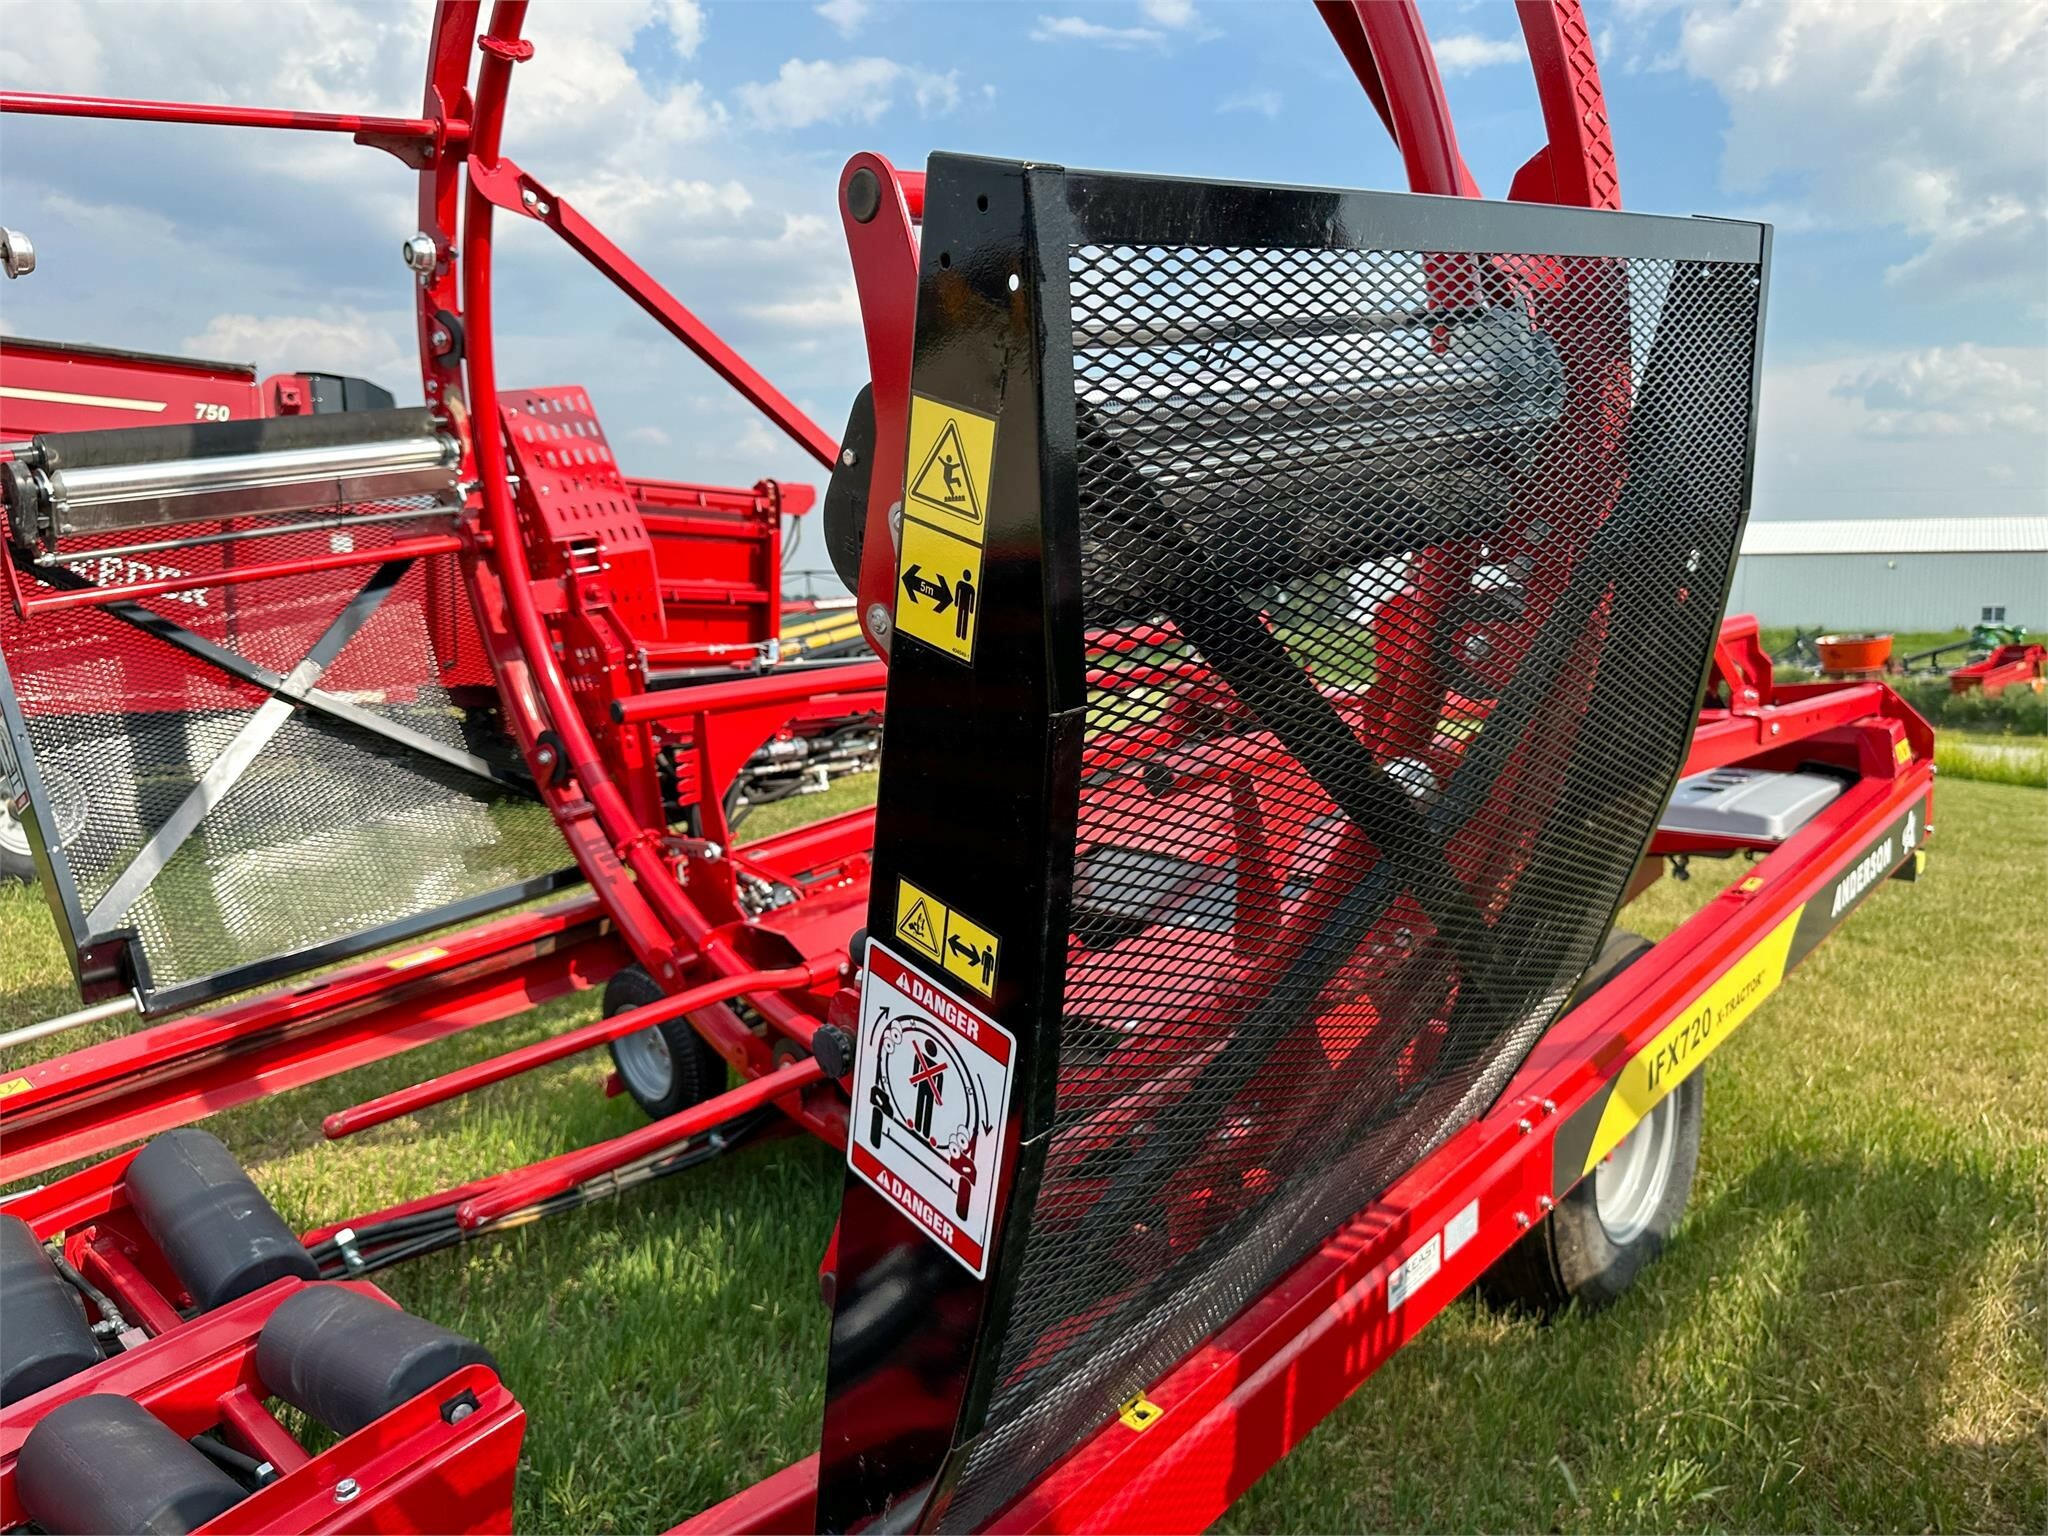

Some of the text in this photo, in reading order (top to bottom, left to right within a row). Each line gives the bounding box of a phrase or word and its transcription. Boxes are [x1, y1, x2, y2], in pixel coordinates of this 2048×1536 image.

[194, 402, 230, 422] 750
[920, 581, 934, 596] 5m
[1831, 837, 1892, 918] ANDERSON
[912, 979, 980, 1041] DANGER
[1647, 1007, 1711, 1092] IFX720
[892, 1178, 954, 1245] DANGER
